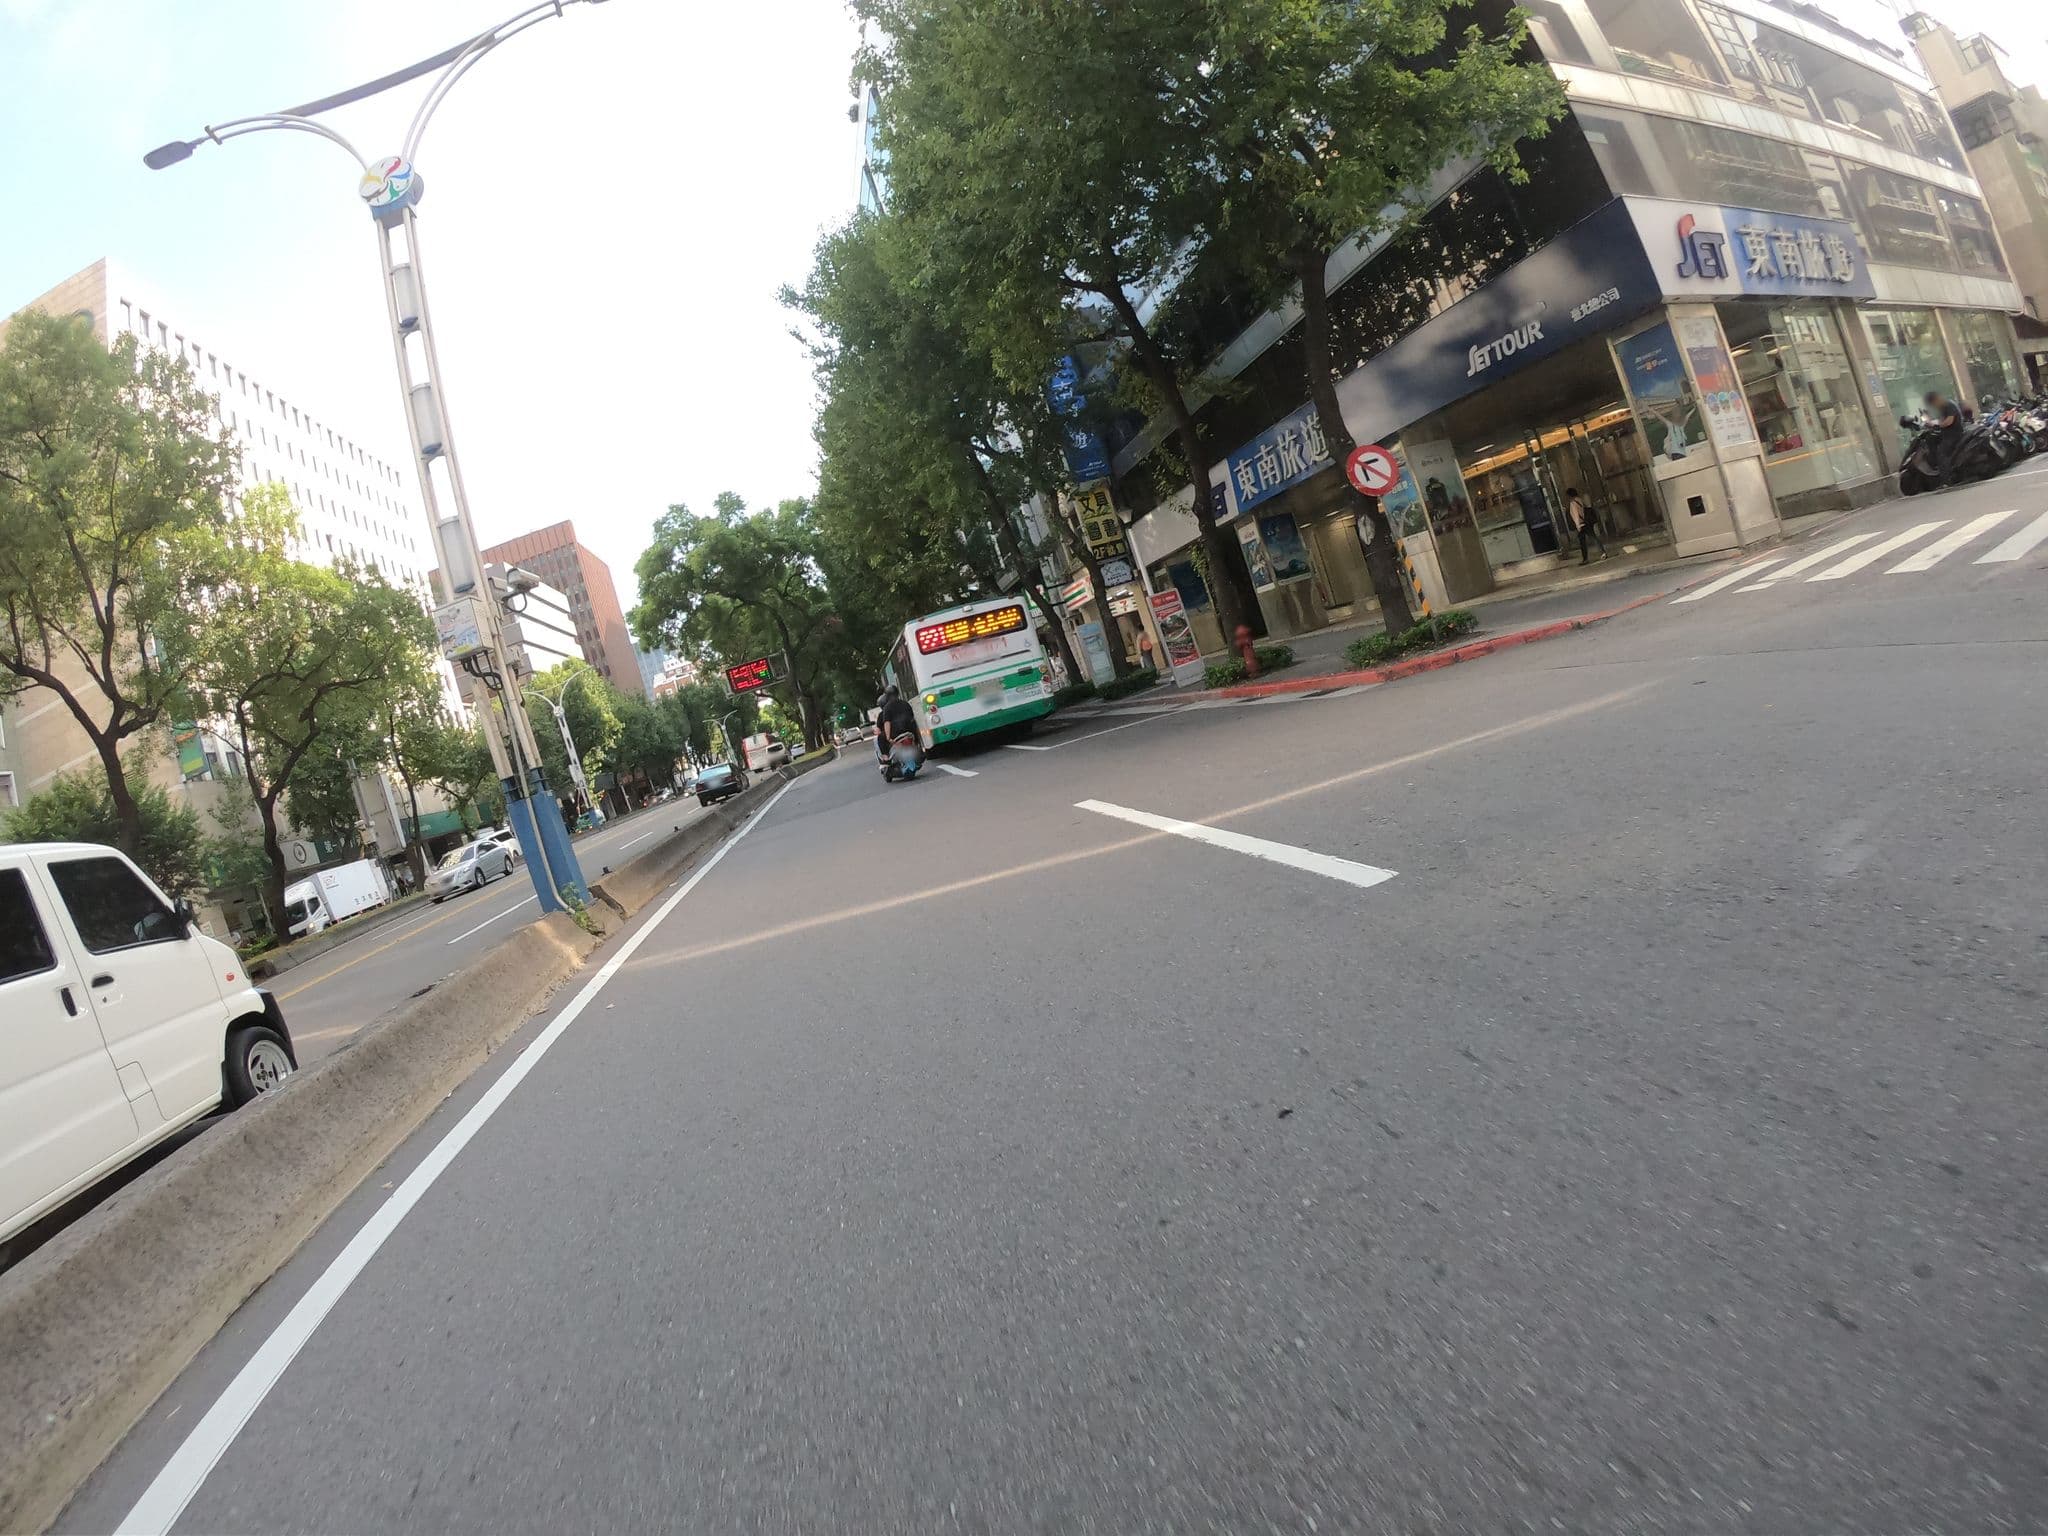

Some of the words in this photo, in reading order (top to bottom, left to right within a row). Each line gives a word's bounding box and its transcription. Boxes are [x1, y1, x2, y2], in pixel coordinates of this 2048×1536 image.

[1735, 223, 1856, 284] 東南旅遊
[1233, 411, 1330, 503] 東南旅遊
